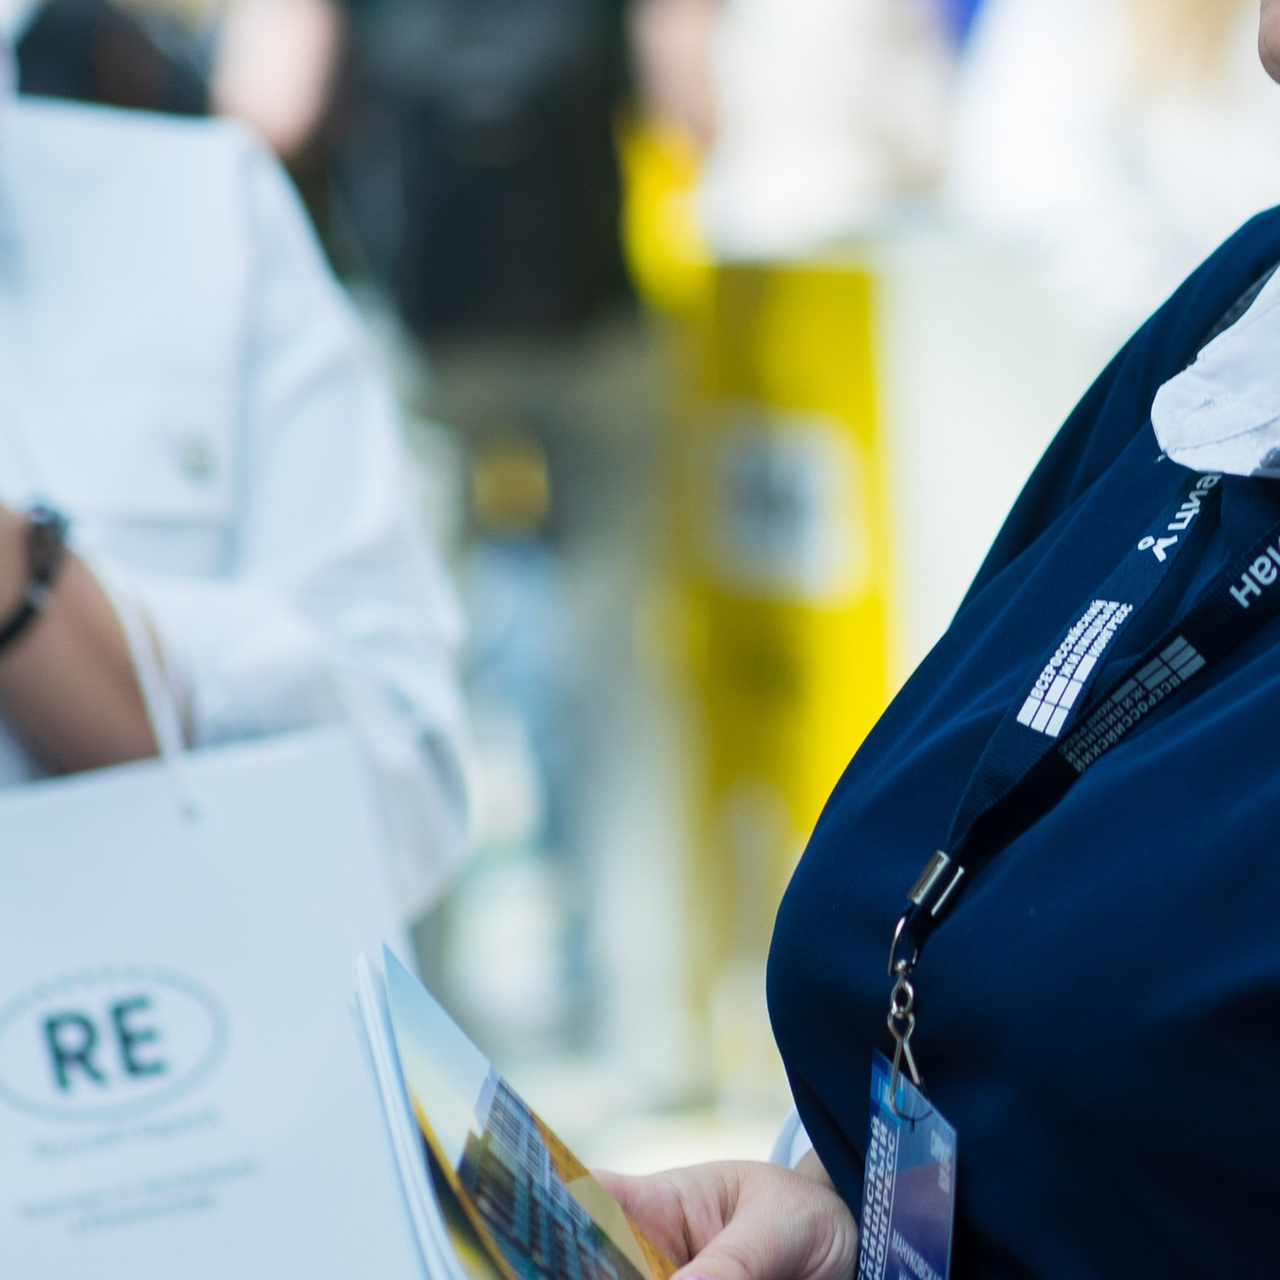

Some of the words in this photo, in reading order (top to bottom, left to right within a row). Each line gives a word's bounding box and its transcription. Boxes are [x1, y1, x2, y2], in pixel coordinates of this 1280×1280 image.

[1167, 473, 1222, 531] циа
[1072, 674, 1182, 774] ВСЕРОССИЙСКИЙ
[42, 993, 170, 1091] RE
